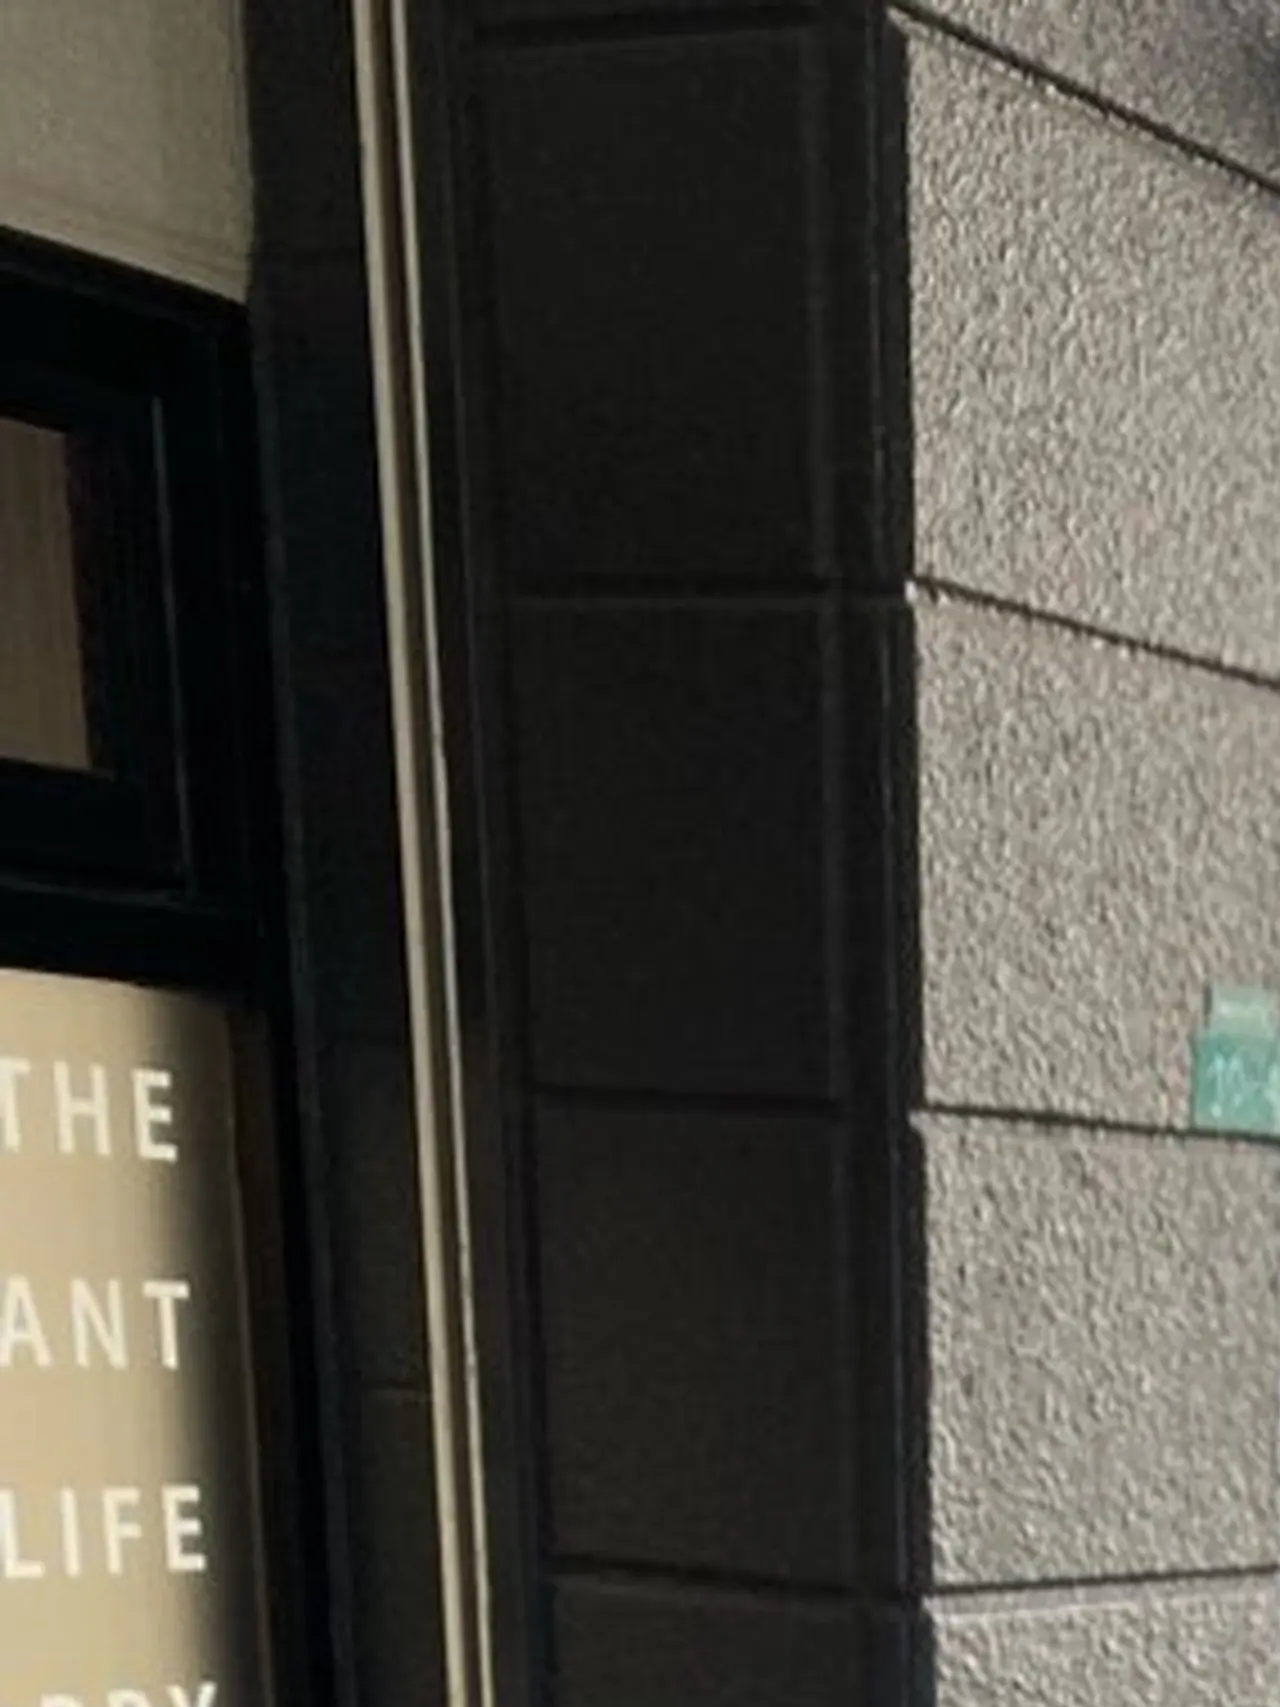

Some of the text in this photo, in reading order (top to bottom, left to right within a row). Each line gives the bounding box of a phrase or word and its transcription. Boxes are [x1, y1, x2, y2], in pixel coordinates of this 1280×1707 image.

[0, 1058, 178, 1162] THE
[0, 1276, 190, 1371] ANT
[0, 1486, 207, 1578] LIFE
